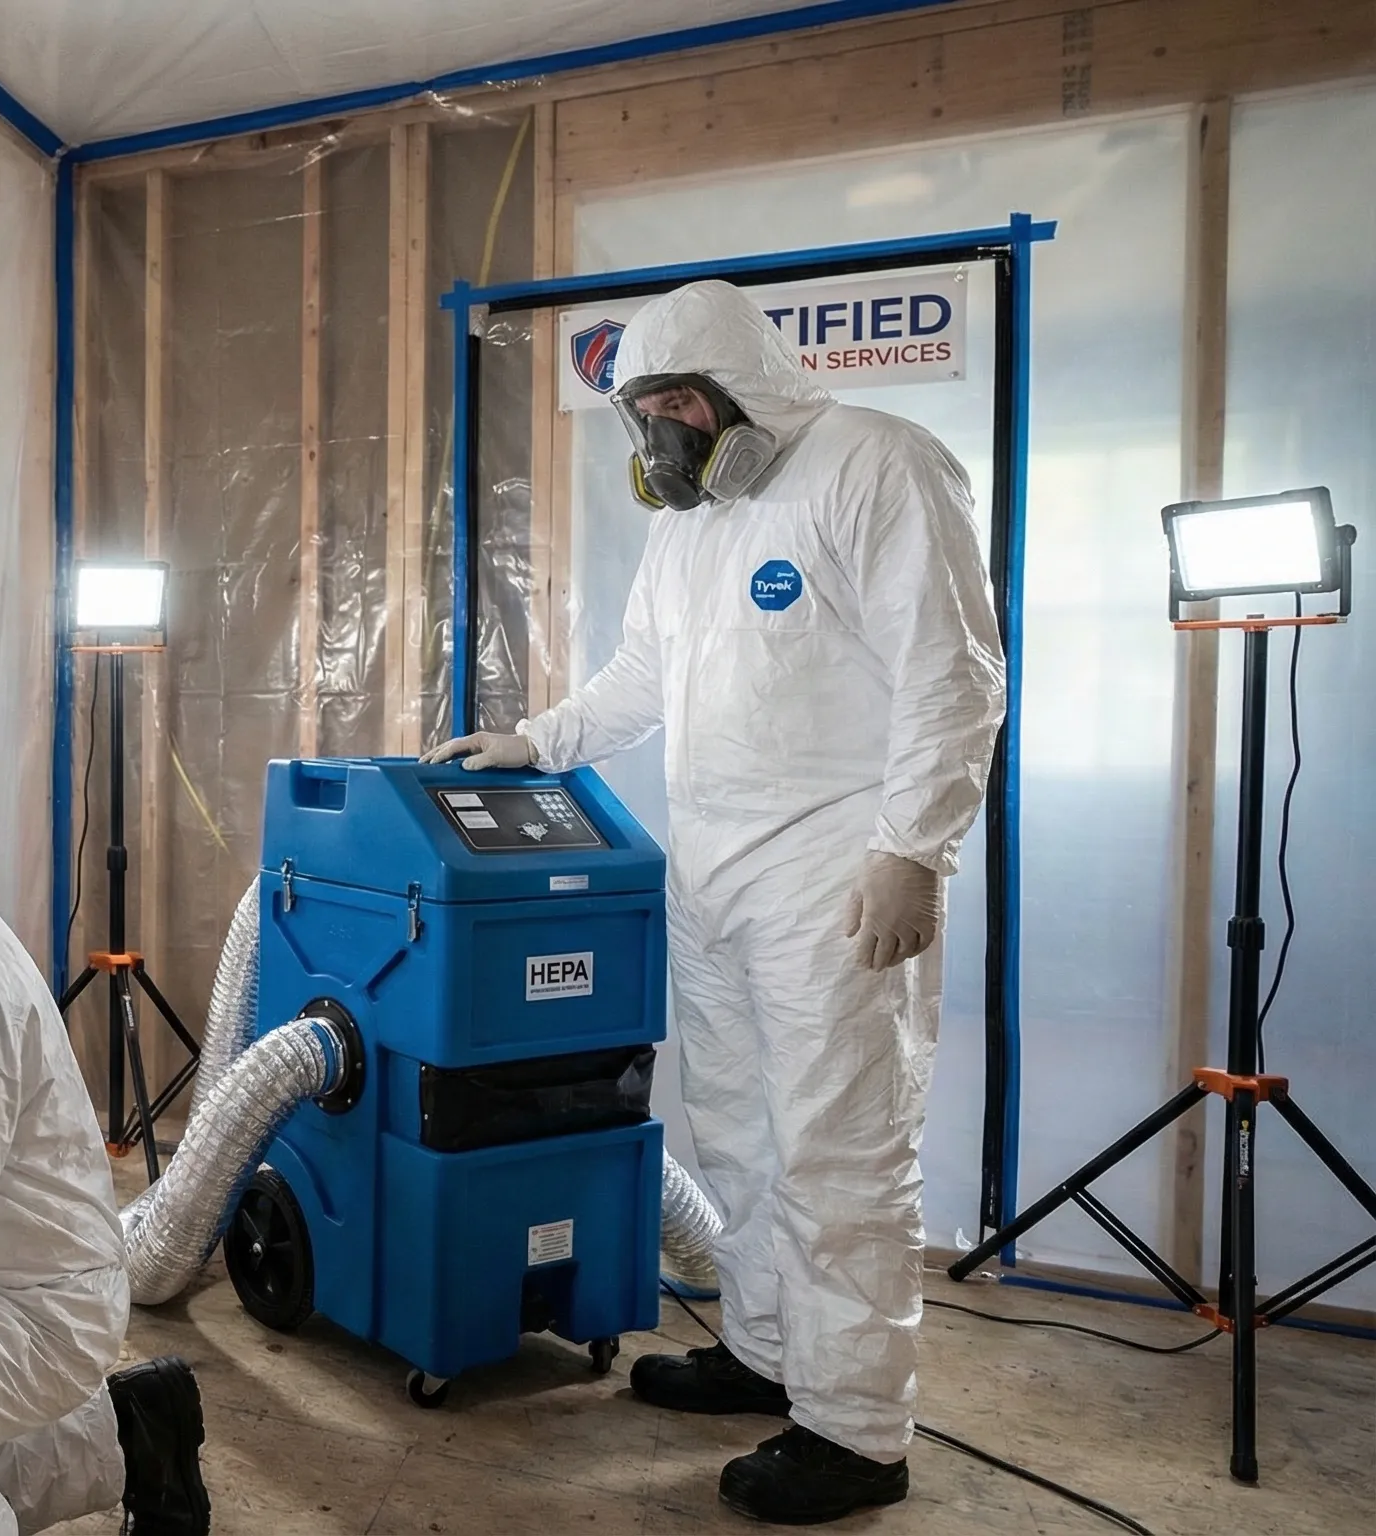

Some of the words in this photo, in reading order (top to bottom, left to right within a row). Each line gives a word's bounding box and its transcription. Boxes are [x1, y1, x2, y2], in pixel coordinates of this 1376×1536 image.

[763, 294, 952, 346] TIFIED
[826, 342, 951, 370] SERVICES
[531, 960, 589, 986] HEPA
